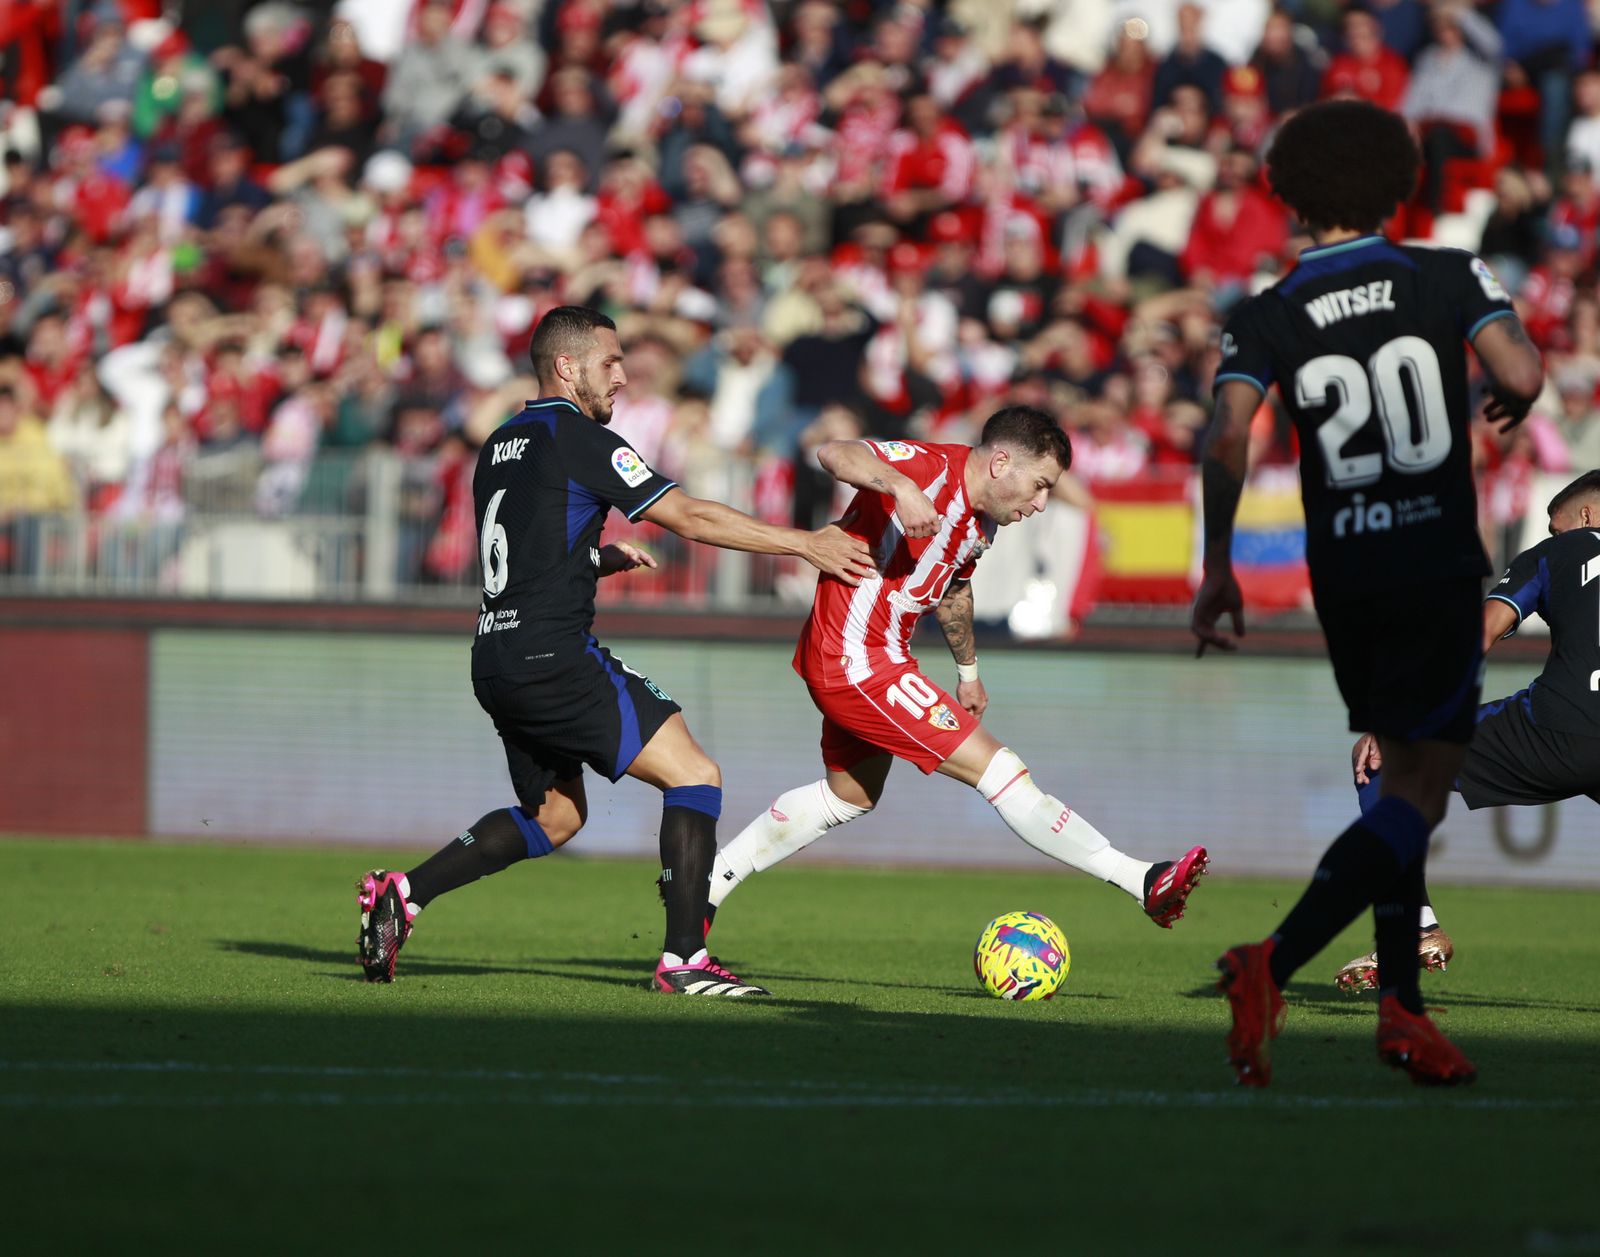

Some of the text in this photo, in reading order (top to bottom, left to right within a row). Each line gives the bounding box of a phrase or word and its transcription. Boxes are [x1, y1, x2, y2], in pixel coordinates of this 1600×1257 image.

[1305, 279, 1396, 330] WITSEL
[1295, 335, 1452, 489] 20
[491, 437, 530, 466] KOKE
[1333, 493, 1392, 538] ria
[481, 488, 508, 599] 6
[477, 602, 495, 636] ia
[886, 672, 938, 719] 10
